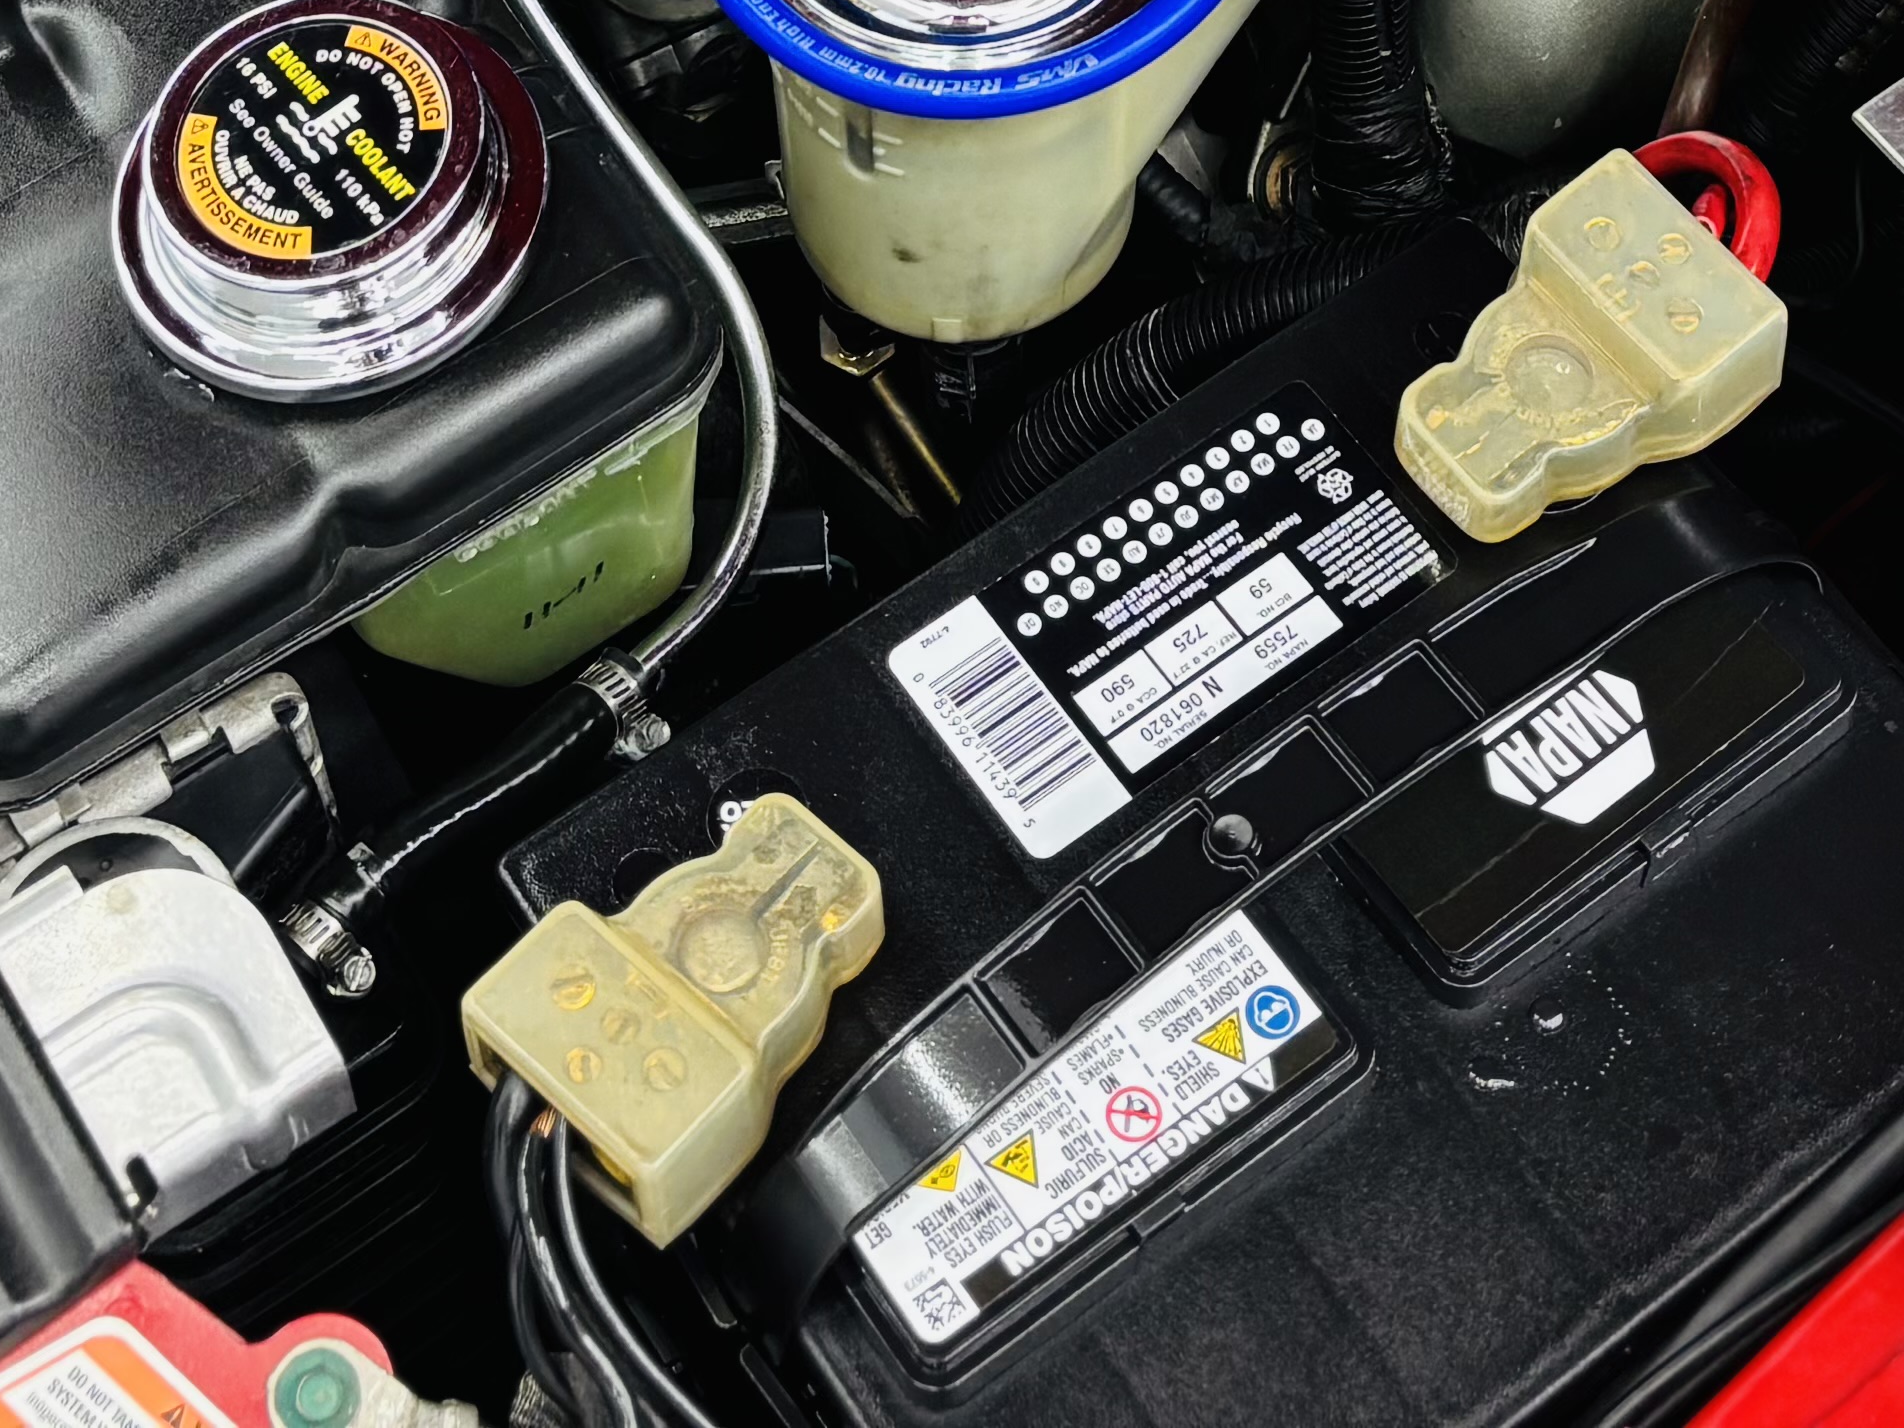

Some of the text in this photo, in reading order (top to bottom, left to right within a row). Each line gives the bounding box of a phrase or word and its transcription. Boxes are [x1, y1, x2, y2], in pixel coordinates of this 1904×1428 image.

[235, 57, 277, 98] 16 PSI
[267, 41, 330, 104] ENGINE
[380, 39, 440, 121] WARNING
[893, 67, 1001, 96] Racing
[315, 48, 414, 153] DO NOT OPEN HOT
[214, 129, 233, 188] OUVRIR
[242, 193, 299, 223] CHAUD
[233, 154, 275, 200] NE PAS
[253, 126, 296, 173] Owner
[293, 172, 333, 219] Guide
[345, 128, 415, 200] COOLANT
[187, 143, 301, 249] AVERTISSEMENT
[335, 168, 383, 225] 110 kPa
[1246, 576, 1273, 601] 59
[1170, 621, 1208, 653] 725
[1251, 622, 1298, 661] 7559
[1099, 672, 1135, 704] 590
[1138, 673, 1223, 743] N 061820
[912, 671, 925, 683] 0
[932, 696, 976, 748] 83996
[974, 751, 1018, 800] 11439
[1494, 677, 1631, 793] NAPA
[1220, 928, 1243, 950] OR
[1136, 942, 1255, 1034] CAN CAUSE BLINDNESS
[1198, 958, 1269, 1015] EXPLOSIVE
[1159, 1004, 1205, 1044] GASES
[1096, 1071, 1121, 1095] NO
[1160, 1048, 1202, 1085] EYES.
[1172, 1059, 1221, 1102] SHIELD
[999, 1086, 1061, 1135] BLINDNESS
[1032, 1100, 1072, 1134] CAUSE
[1055, 1115, 1083, 1140] CAN
[981, 1128, 1003, 1149] OR
[1059, 1130, 1095, 1162] ACID
[954, 1177, 989, 1209] WITH
[997, 1081, 1251, 1277] DANGER/POISON
[1042, 1145, 1108, 1200] SULFURIC
[861, 1219, 893, 1249] GET
[911, 1199, 959, 1240] WATER.
[920, 1193, 1002, 1259] IMMEDIATELY
[942, 1210, 1013, 1268] FLUSH EYES
[67, 1365, 88, 1388] DO
[85, 1383, 115, 1409] NOT
